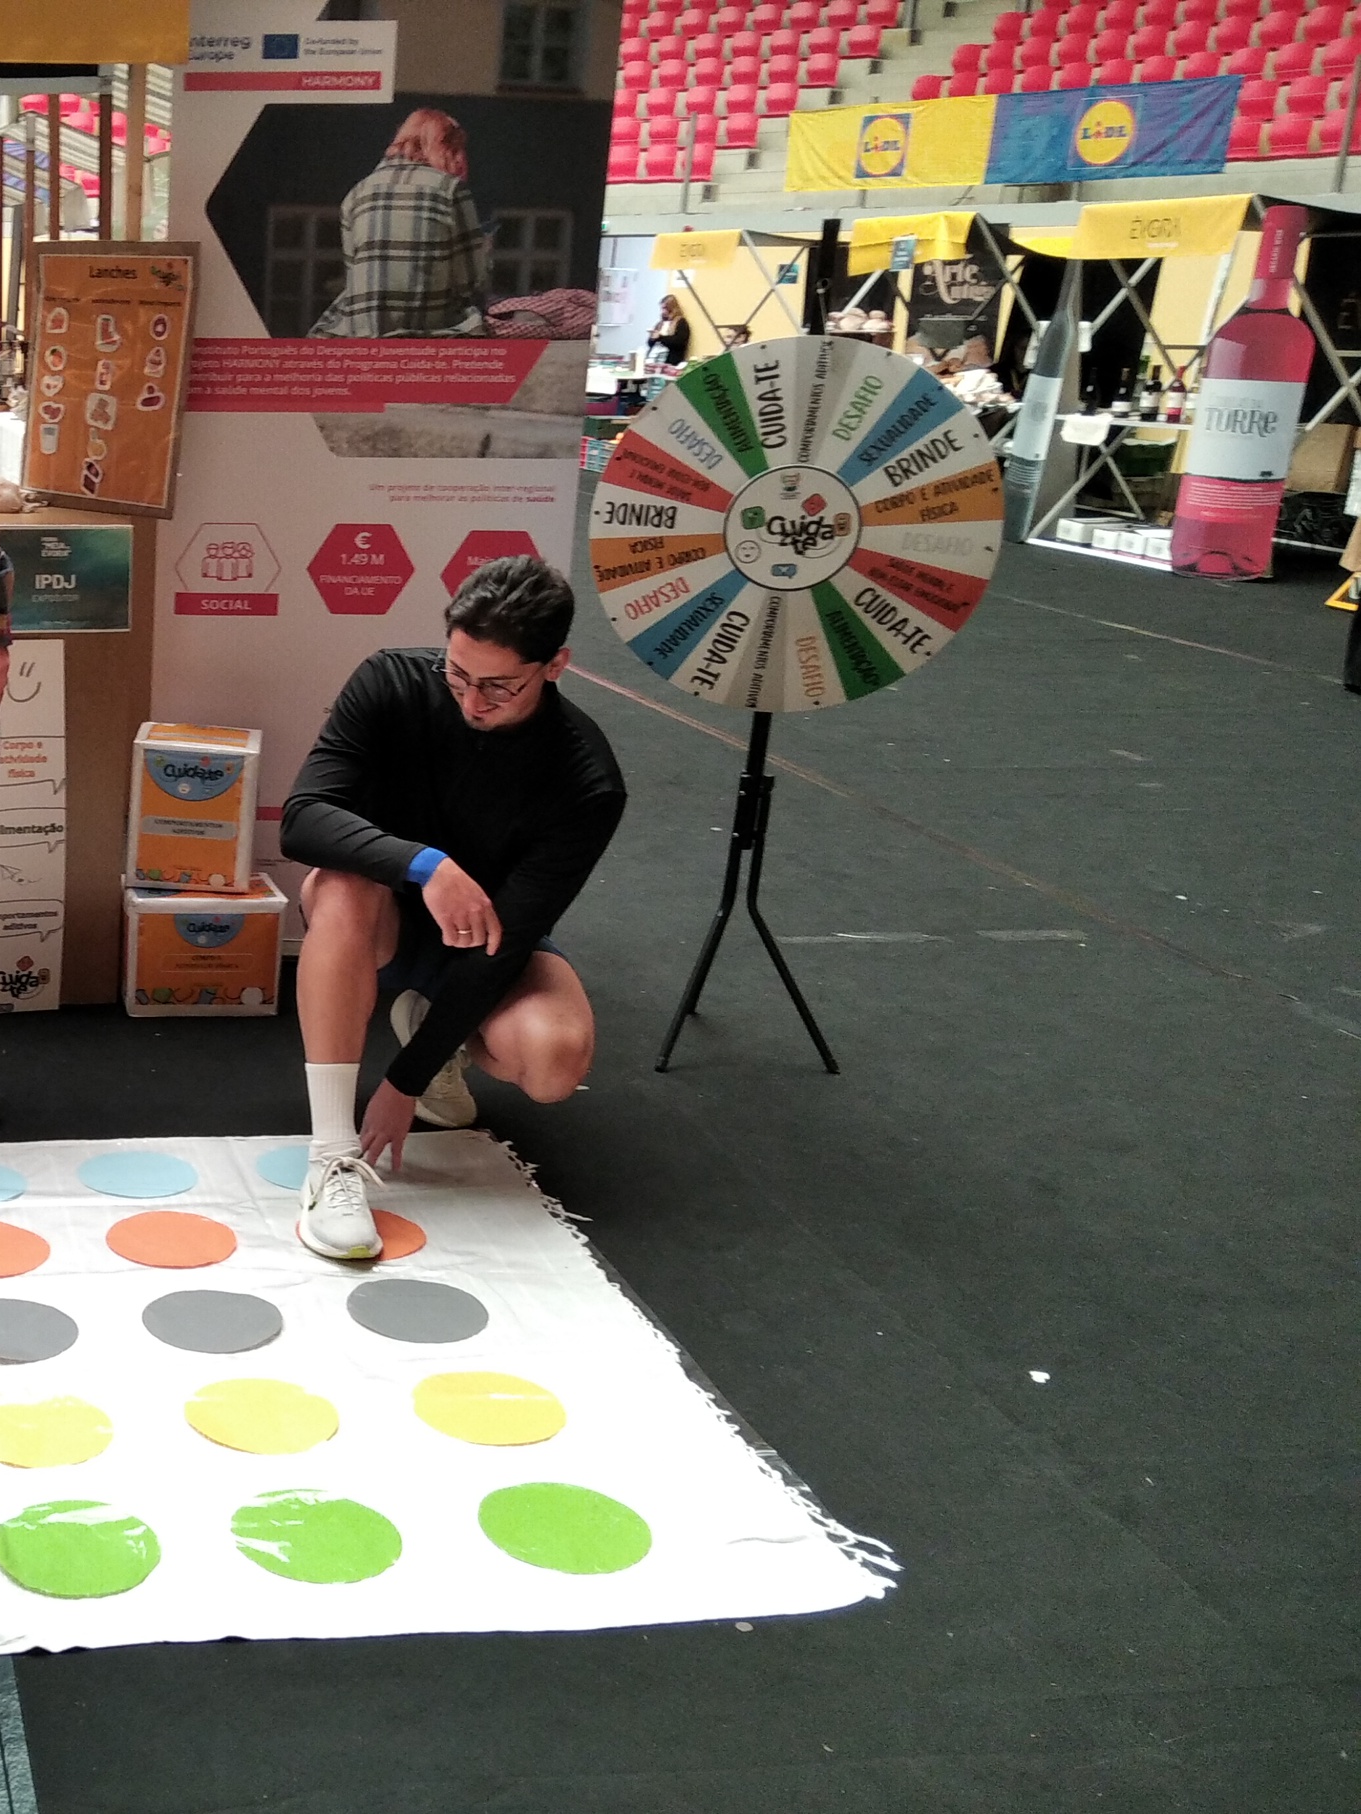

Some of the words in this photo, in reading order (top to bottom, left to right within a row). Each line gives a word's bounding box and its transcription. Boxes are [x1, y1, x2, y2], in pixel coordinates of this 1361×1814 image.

[189, 36, 252, 49] nterreg
[301, 75, 377, 87] HARMONY
[89, 265, 138, 280] Lanches
[192, 345, 239, 355] nstituto
[242, 345, 298, 358] Português
[300, 345, 314, 355] do
[315, 345, 369, 358] Desporto
[437, 346, 490, 358] participa
[490, 348, 507, 356] no
[222, 359, 281, 369] HARMONY
[282, 359, 324, 369] através
[326, 359, 341, 369] do
[342, 359, 399, 371] Programa
[451, 360, 504, 370] Pretende
[235, 374, 263, 384] para
[324, 373, 346, 383] das
[442, 374, 517, 383] relacionadas
[214, 385, 248, 395] saúde
[248, 386, 289, 395] mental
[752, 359, 788, 449] CUIDA-TE
[831, 374, 884, 442] DESAFIO
[856, 393, 938, 467] SEXUALIDADE
[666, 418, 723, 471] DESAFIO
[882, 429, 965, 488] BRINDE
[874, 491, 916, 514] CORPO
[603, 501, 678, 530] BRINDE
[34, 573, 77, 590] IPDJ
[319, 574, 403, 585] FINANCIAMENTO
[344, 586, 360, 596] DA
[624, 576, 690, 621] DESAFIO
[200, 599, 252, 611] SOCIAL
[854, 587, 933, 654] CUIDA-TE
[690, 610, 751, 691] CUIDA-TE
[794, 635, 825, 698] DESAFIO
[2, 741, 34, 752] Corpo
